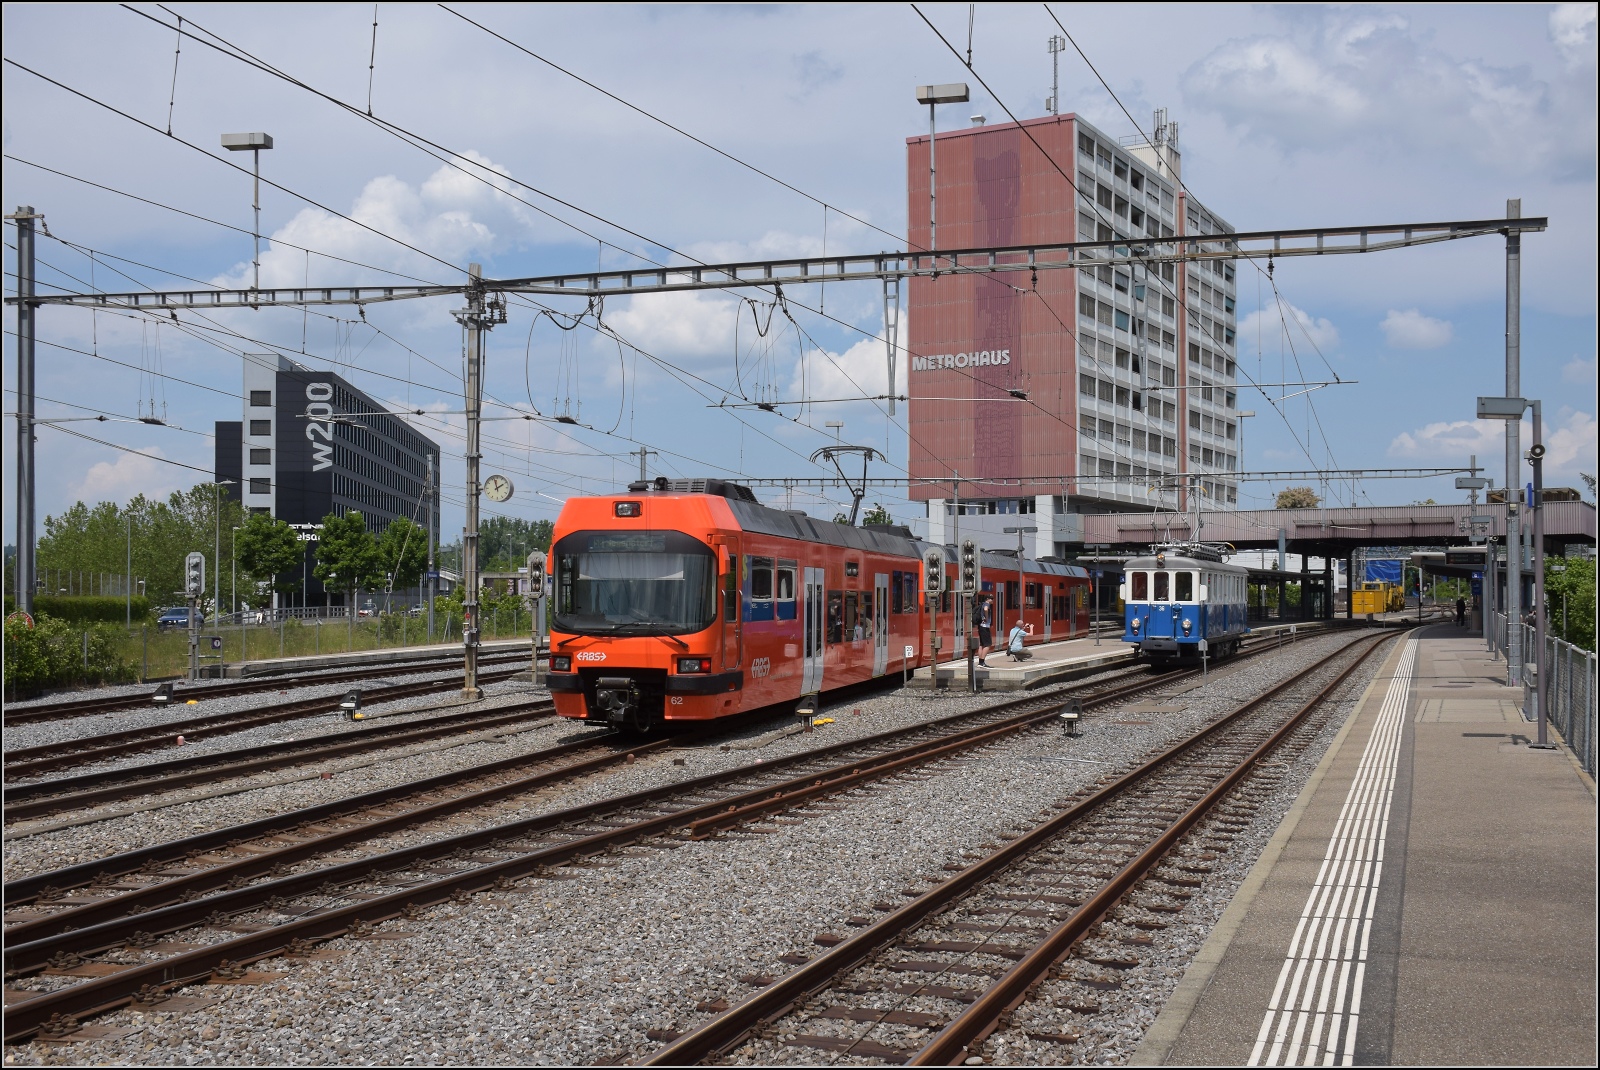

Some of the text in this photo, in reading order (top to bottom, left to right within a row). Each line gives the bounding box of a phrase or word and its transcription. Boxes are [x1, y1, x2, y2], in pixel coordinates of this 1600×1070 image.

[912, 349, 1011, 371] METROHAUS
[296, 532, 321, 541] elsa
[580, 651, 603, 662] RBS
[753, 657, 769, 678] RBS
[670, 696, 683, 705] 62
